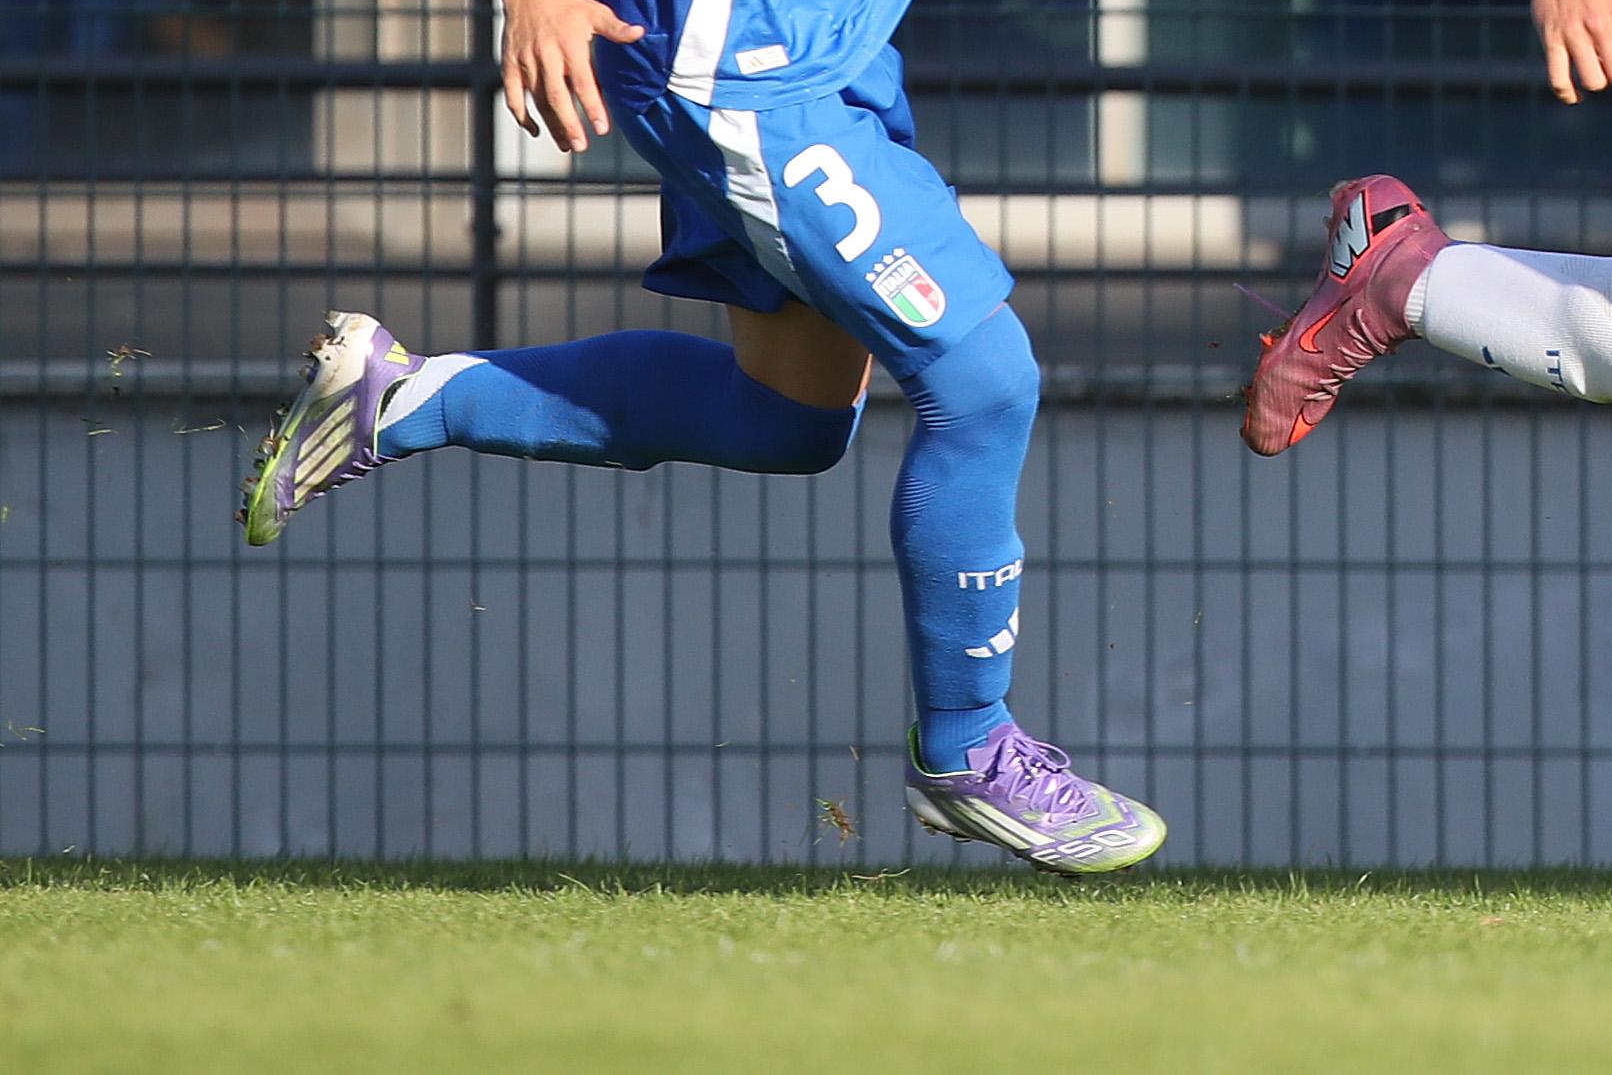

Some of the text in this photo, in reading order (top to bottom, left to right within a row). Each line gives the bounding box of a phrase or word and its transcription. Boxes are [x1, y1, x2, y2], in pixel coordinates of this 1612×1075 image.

[783, 143, 882, 263] 3
[878, 261, 916, 296] ITALIA
[1030, 829, 1137, 866] F50
